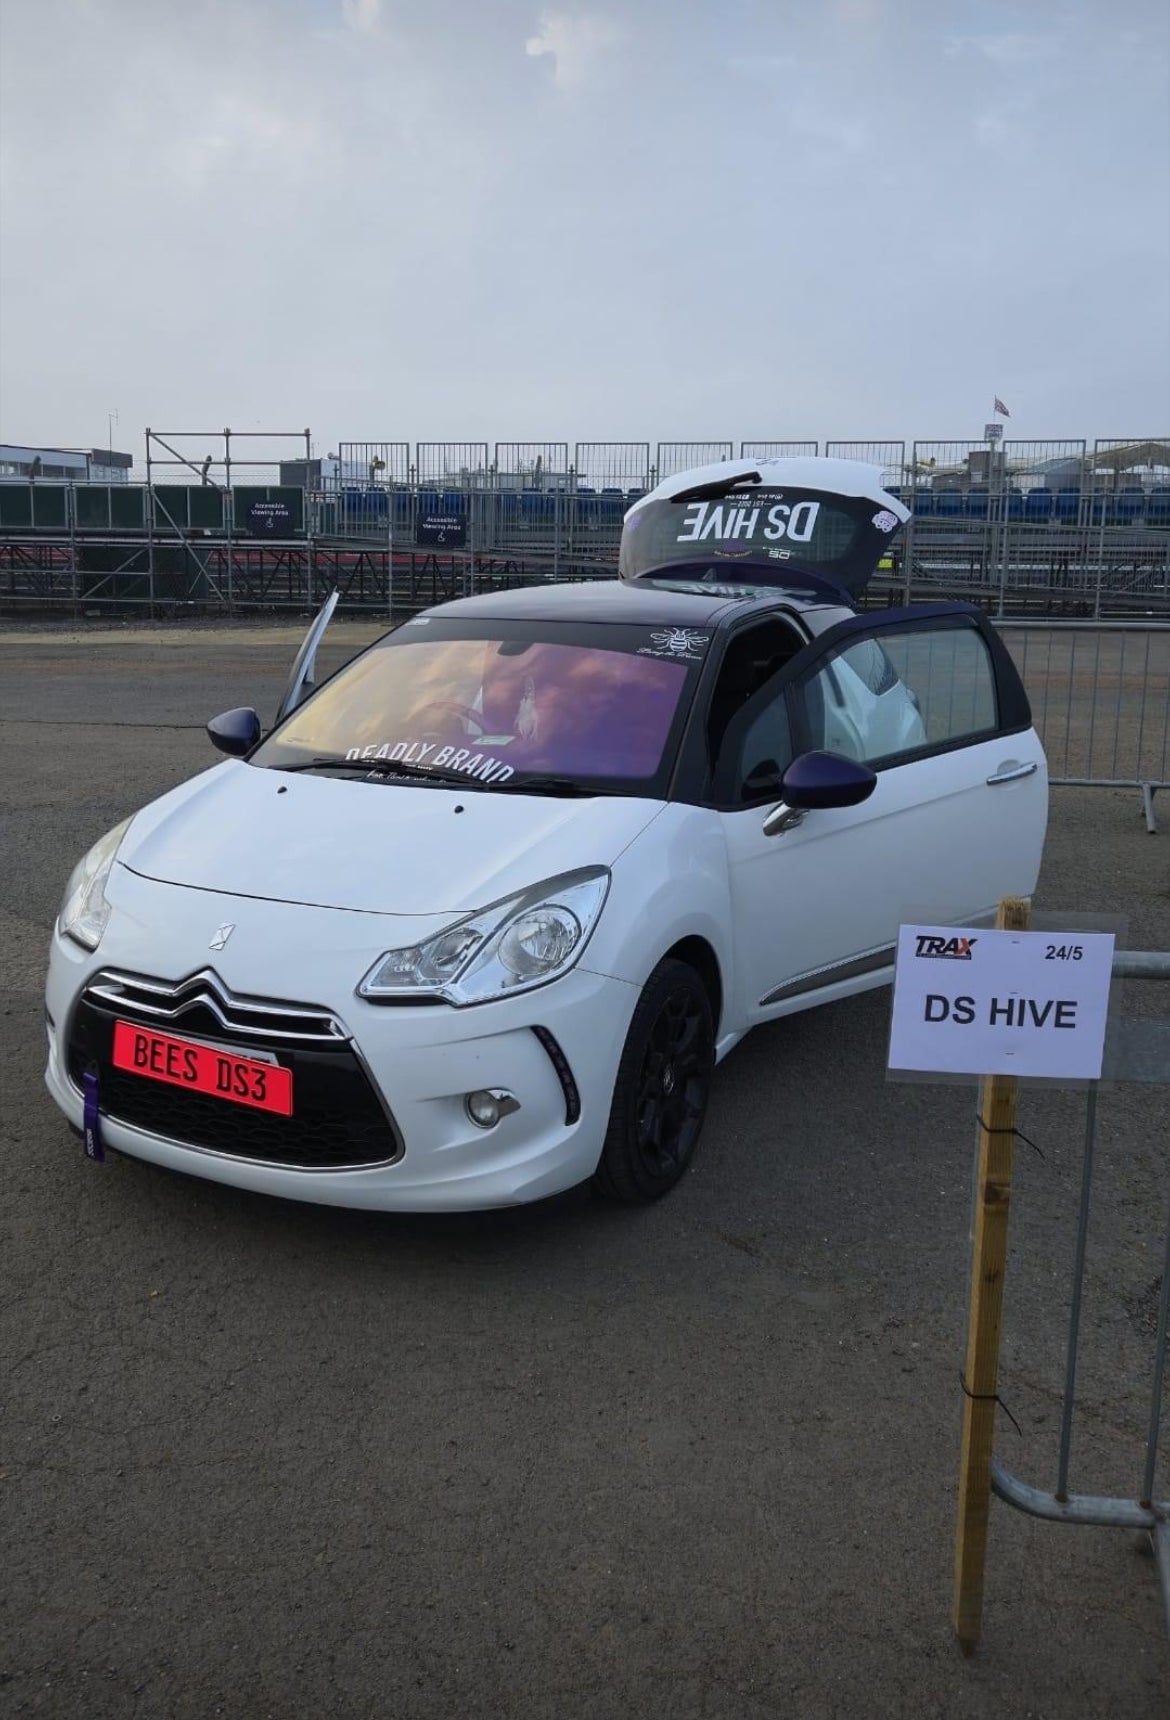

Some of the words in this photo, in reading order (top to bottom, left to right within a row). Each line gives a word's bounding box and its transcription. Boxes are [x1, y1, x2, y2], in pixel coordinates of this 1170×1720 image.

[422, 523, 446, 531] Viewing
[677, 502, 760, 542] HIVE
[763, 501, 820, 542] DS
[432, 745, 515, 783] BRAND
[916, 935, 978, 956] TRAX
[1044, 944, 1084, 961] 24/5
[924, 993, 976, 1025] DS
[989, 998, 1078, 1028] HIVE
[134, 1034, 198, 1083] BEES
[217, 1059, 266, 1101] DS3
